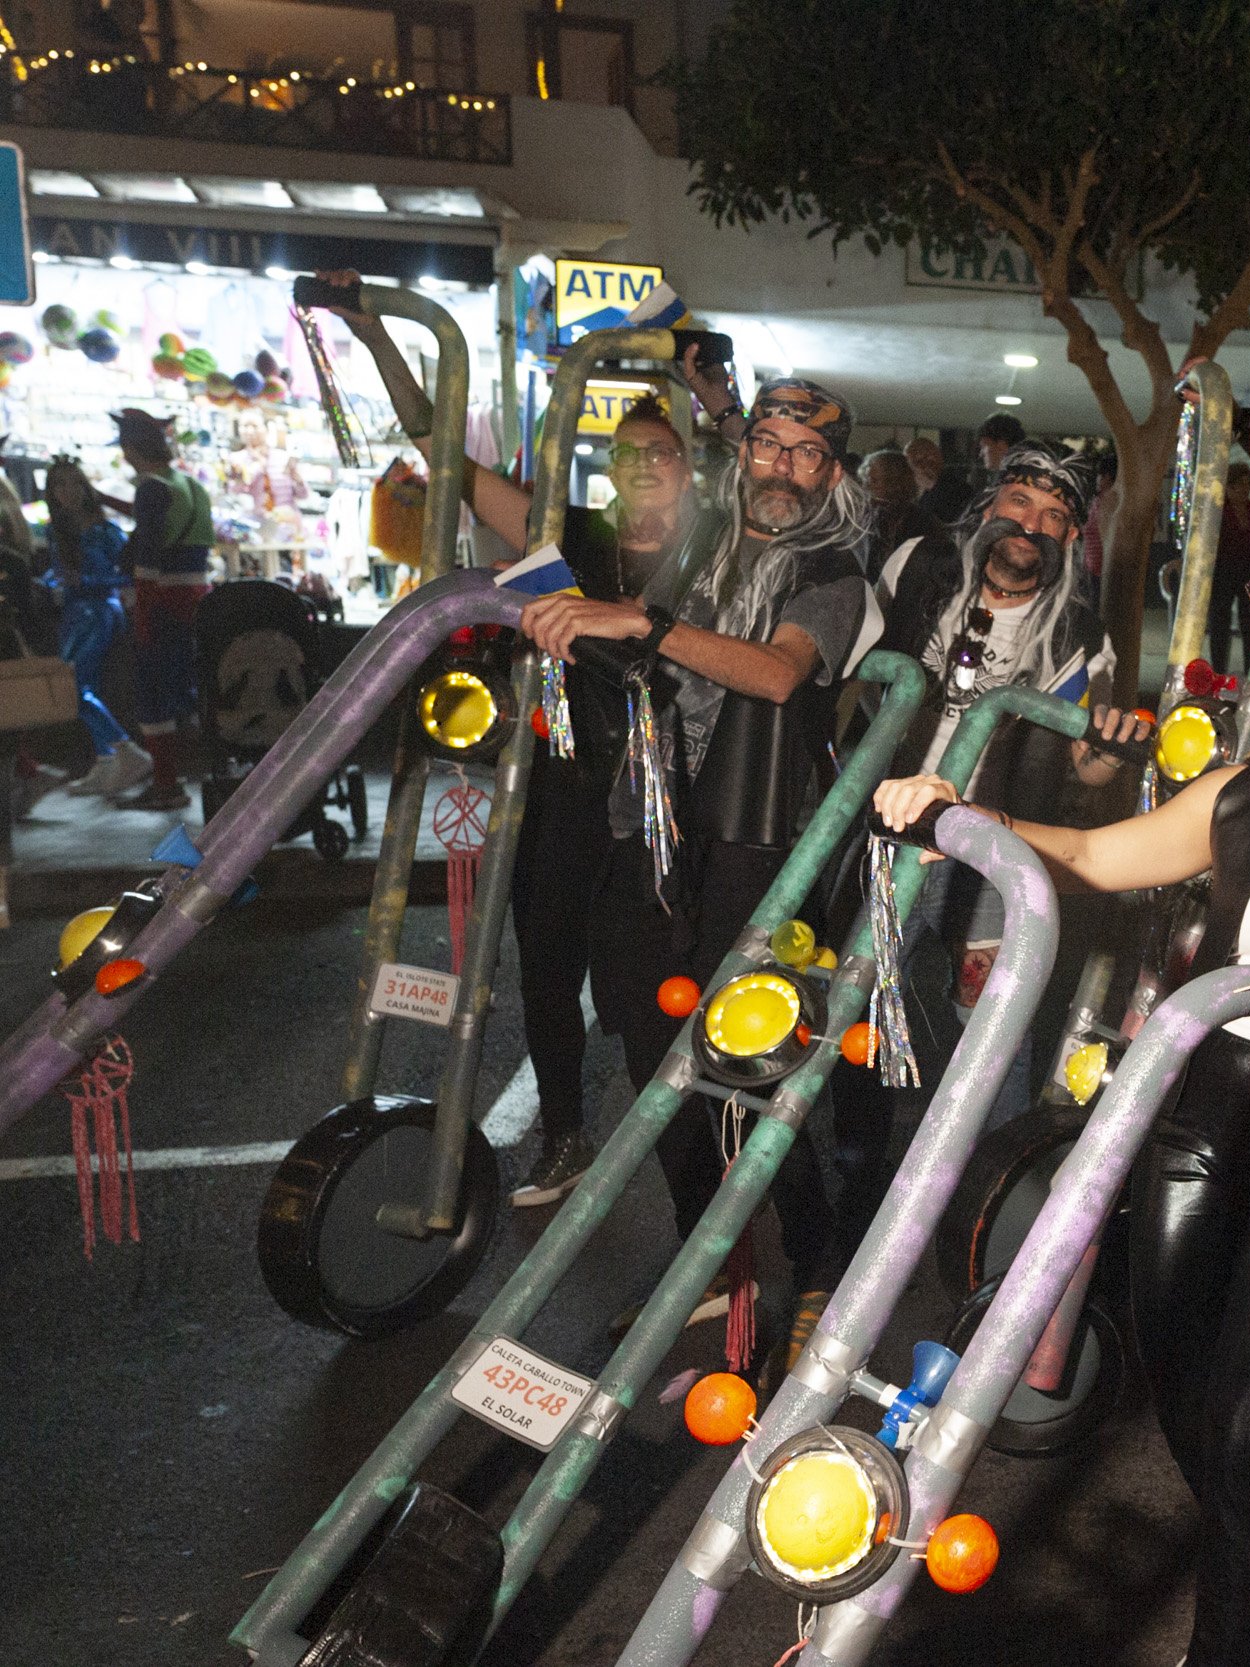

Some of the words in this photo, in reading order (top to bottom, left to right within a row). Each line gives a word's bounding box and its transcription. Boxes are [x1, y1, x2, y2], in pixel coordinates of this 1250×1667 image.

[565, 268, 655, 302] ATM
[384, 980, 449, 1006] 31AP48
[386, 999, 409, 1011] CASA
[411, 1004, 440, 1018] MAJINA
[491, 1344, 522, 1367] CALETA
[523, 1362, 562, 1387] CABALLO
[561, 1380, 586, 1398] TOWN
[482, 1364, 568, 1417] 43PC48
[481, 1396, 494, 1411] EL
[495, 1403, 533, 1430] SOLAR
